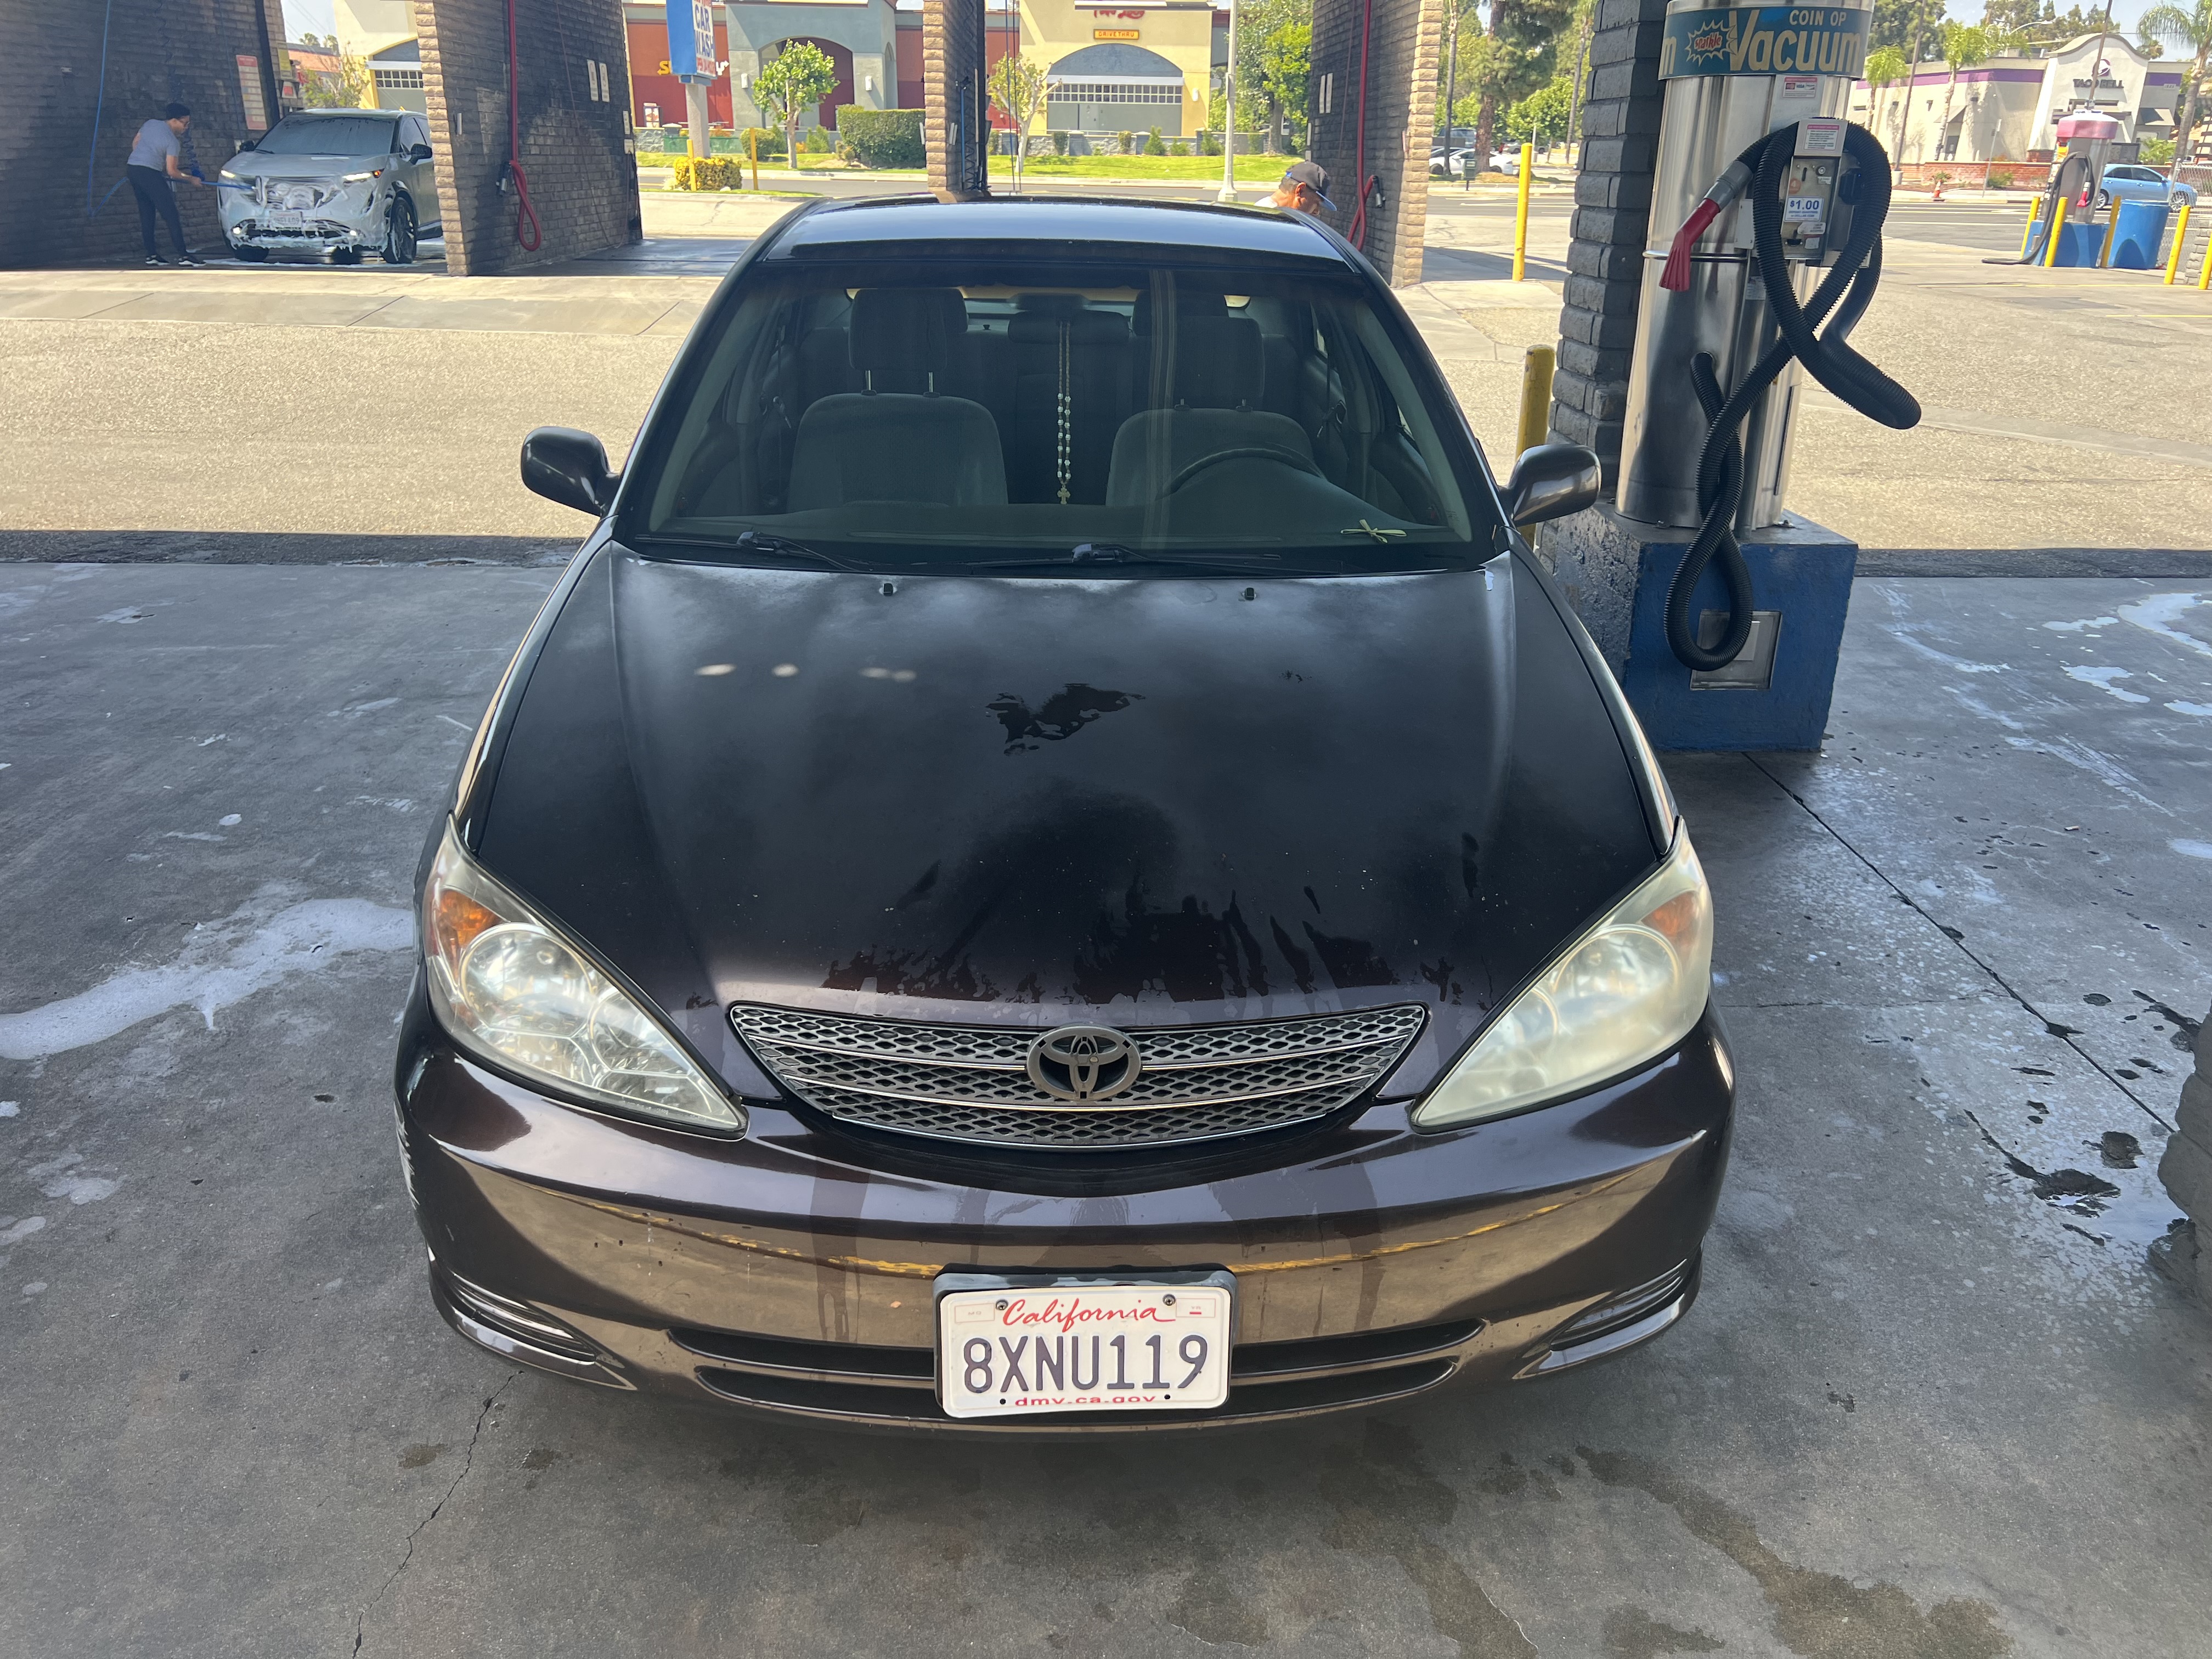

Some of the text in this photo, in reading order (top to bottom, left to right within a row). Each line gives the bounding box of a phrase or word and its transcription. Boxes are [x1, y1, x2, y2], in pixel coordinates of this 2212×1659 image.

[695, 4, 711, 33] CAR
[1789, 9, 1847, 26] COIN OP
[695, 30, 715, 59] WASH
[1695, 32, 1722, 49] sparkle
[1729, 9, 1861, 73] Vacuum
[2100, 79, 2125, 89] BELL
[1790, 200, 1820, 210] $1.00
[1002, 1297, 1176, 1333] California
[963, 1334, 1208, 1394] 8XNU119
[1014, 1396, 1156, 1407] dmv.ca.gov
